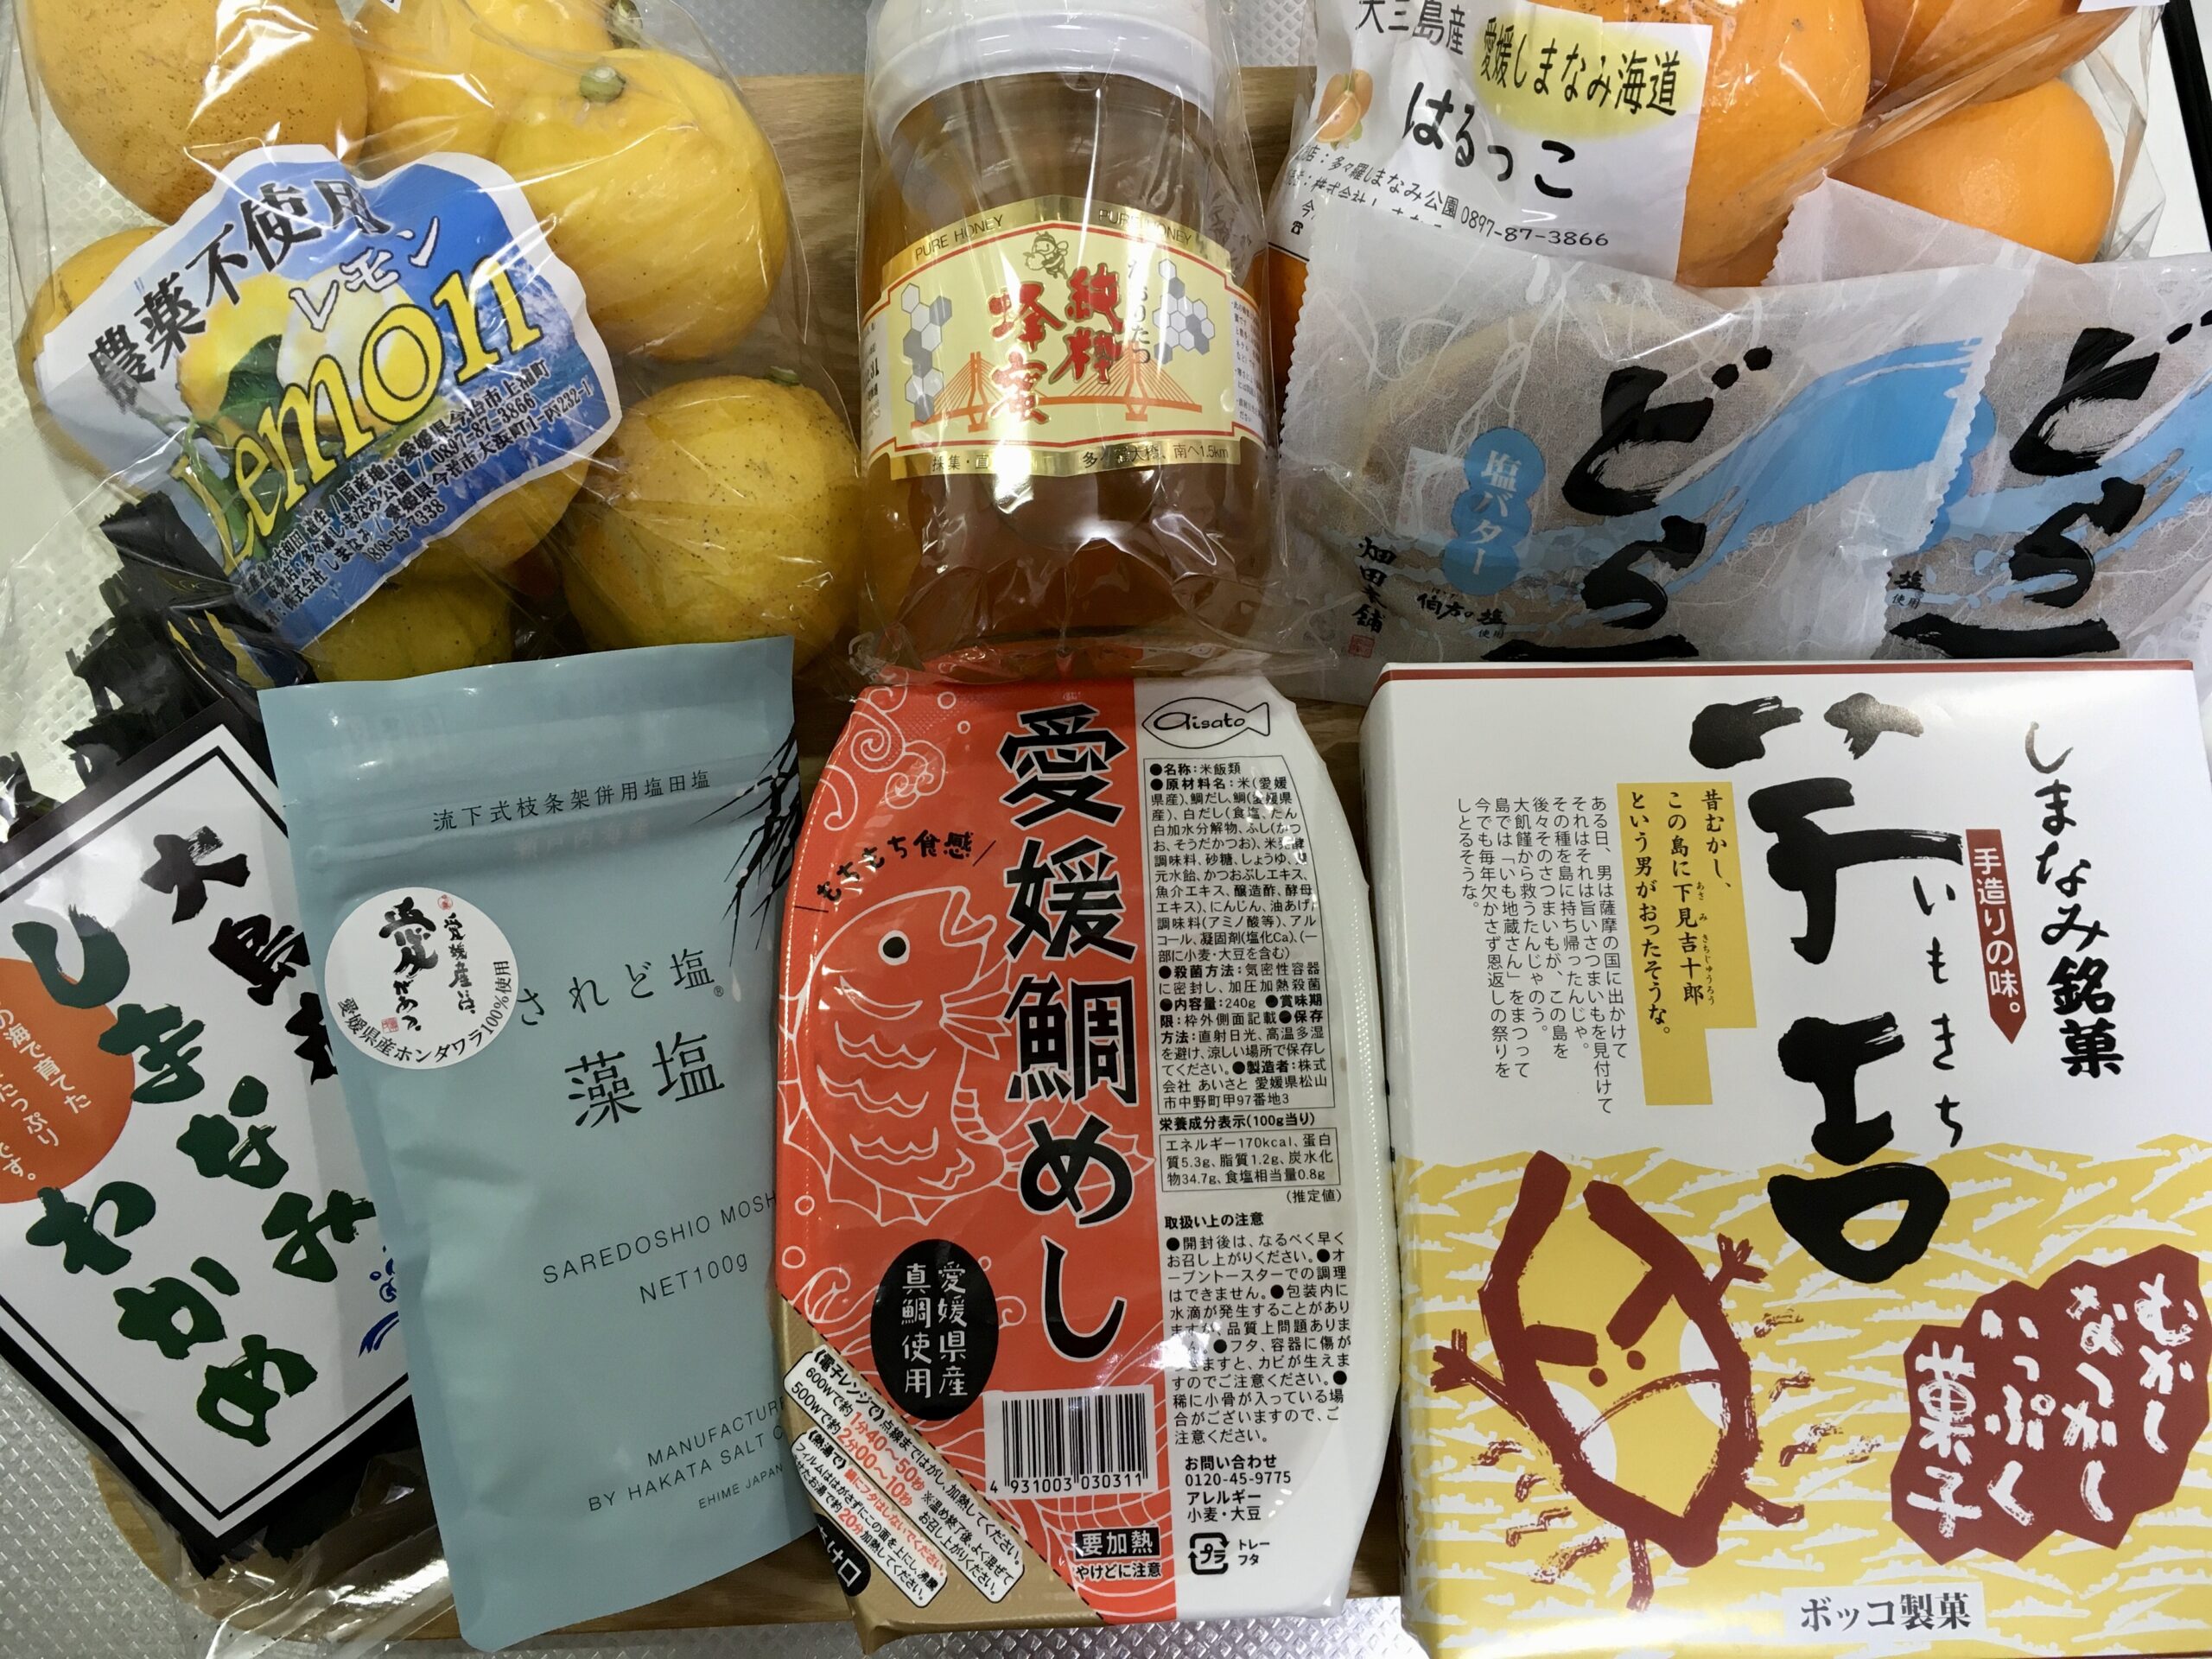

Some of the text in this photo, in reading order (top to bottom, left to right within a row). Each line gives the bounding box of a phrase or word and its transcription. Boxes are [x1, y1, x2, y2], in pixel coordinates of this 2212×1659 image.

[1355, 0, 1465, 55] 大三島産
[1479, 16, 1681, 118] 愛媛しまなみ海道
[1402, 80, 1577, 200] はるっこ
[290, 216, 441, 333] レモン
[915, 214, 1003, 261] PURE HONEY
[1460, 205, 1610, 248] 0897-87-3866
[88, 177, 393, 415] 農薬不使用
[169, 254, 543, 577] Lemon
[1466, 449, 1522, 575] 塩バター
[433, 769, 712, 832] 流下式枝条架併用塩田塩
[1458, 798, 1479, 908] しとるそうな。
[1552, 796, 1590, 1050] その種を島に持ち帰ったんじゃ。
[1630, 791, 1671, 1034] という男がおったそうな。
[1667, 791, 1705, 1007] この島に下見吉十郎
[1973, 847, 2022, 1015] 手造りの味。
[2024, 721, 2125, 1079] しまなみ銘菓
[1571, 796, 1613, 1115] それはそれは旨いさつまいもを見付けて
[337, 959, 513, 1065] 愛媛県産ホンダワラ100%使用
[995, 701, 1140, 1363] 愛媛鯛めし
[1912, 874, 1965, 1148] いもきち
[563, 1030, 726, 1129] 藻塩
[542, 1214, 711, 1285] SAREDOSHIO
[1164, 1211, 1266, 1230] 取扱い上の注意
[25, 1179, 319, 1448] わかめ
[639, 1251, 750, 1304] NET100g
[937, 1259, 969, 1398] 愛媛県産
[900, 1261, 932, 1401] 真鯛使用
[2134, 1272, 2198, 1455] むかし
[1174, 1427, 1269, 1446] 注意ください。
[1906, 1340, 1983, 1540] 菓子
[1980, 1308, 2056, 1527] いっぷく
[2062, 1284, 2128, 1523] なつかし
[588, 1491, 616, 1513] BY
[627, 1456, 713, 1502] HAKATA
[719, 1432, 765, 1465] SALT
[698, 1461, 784, 1510] EHIME JAPAN
[1185, 1453, 1278, 1471] お問い合わせ
[1185, 1470, 1292, 1487] 0120-45-9775
[1186, 1489, 1262, 1506] アレルギー
[1187, 1505, 1262, 1523] 小麦・大豆
[1075, 1560, 1162, 1580] やけどに注意
[1082, 1529, 1154, 1556] 要加熱
[1237, 1537, 1271, 1552] トレー
[1237, 1553, 1260, 1567] フタ
[1800, 1591, 1971, 1632] ボッコ製菓
